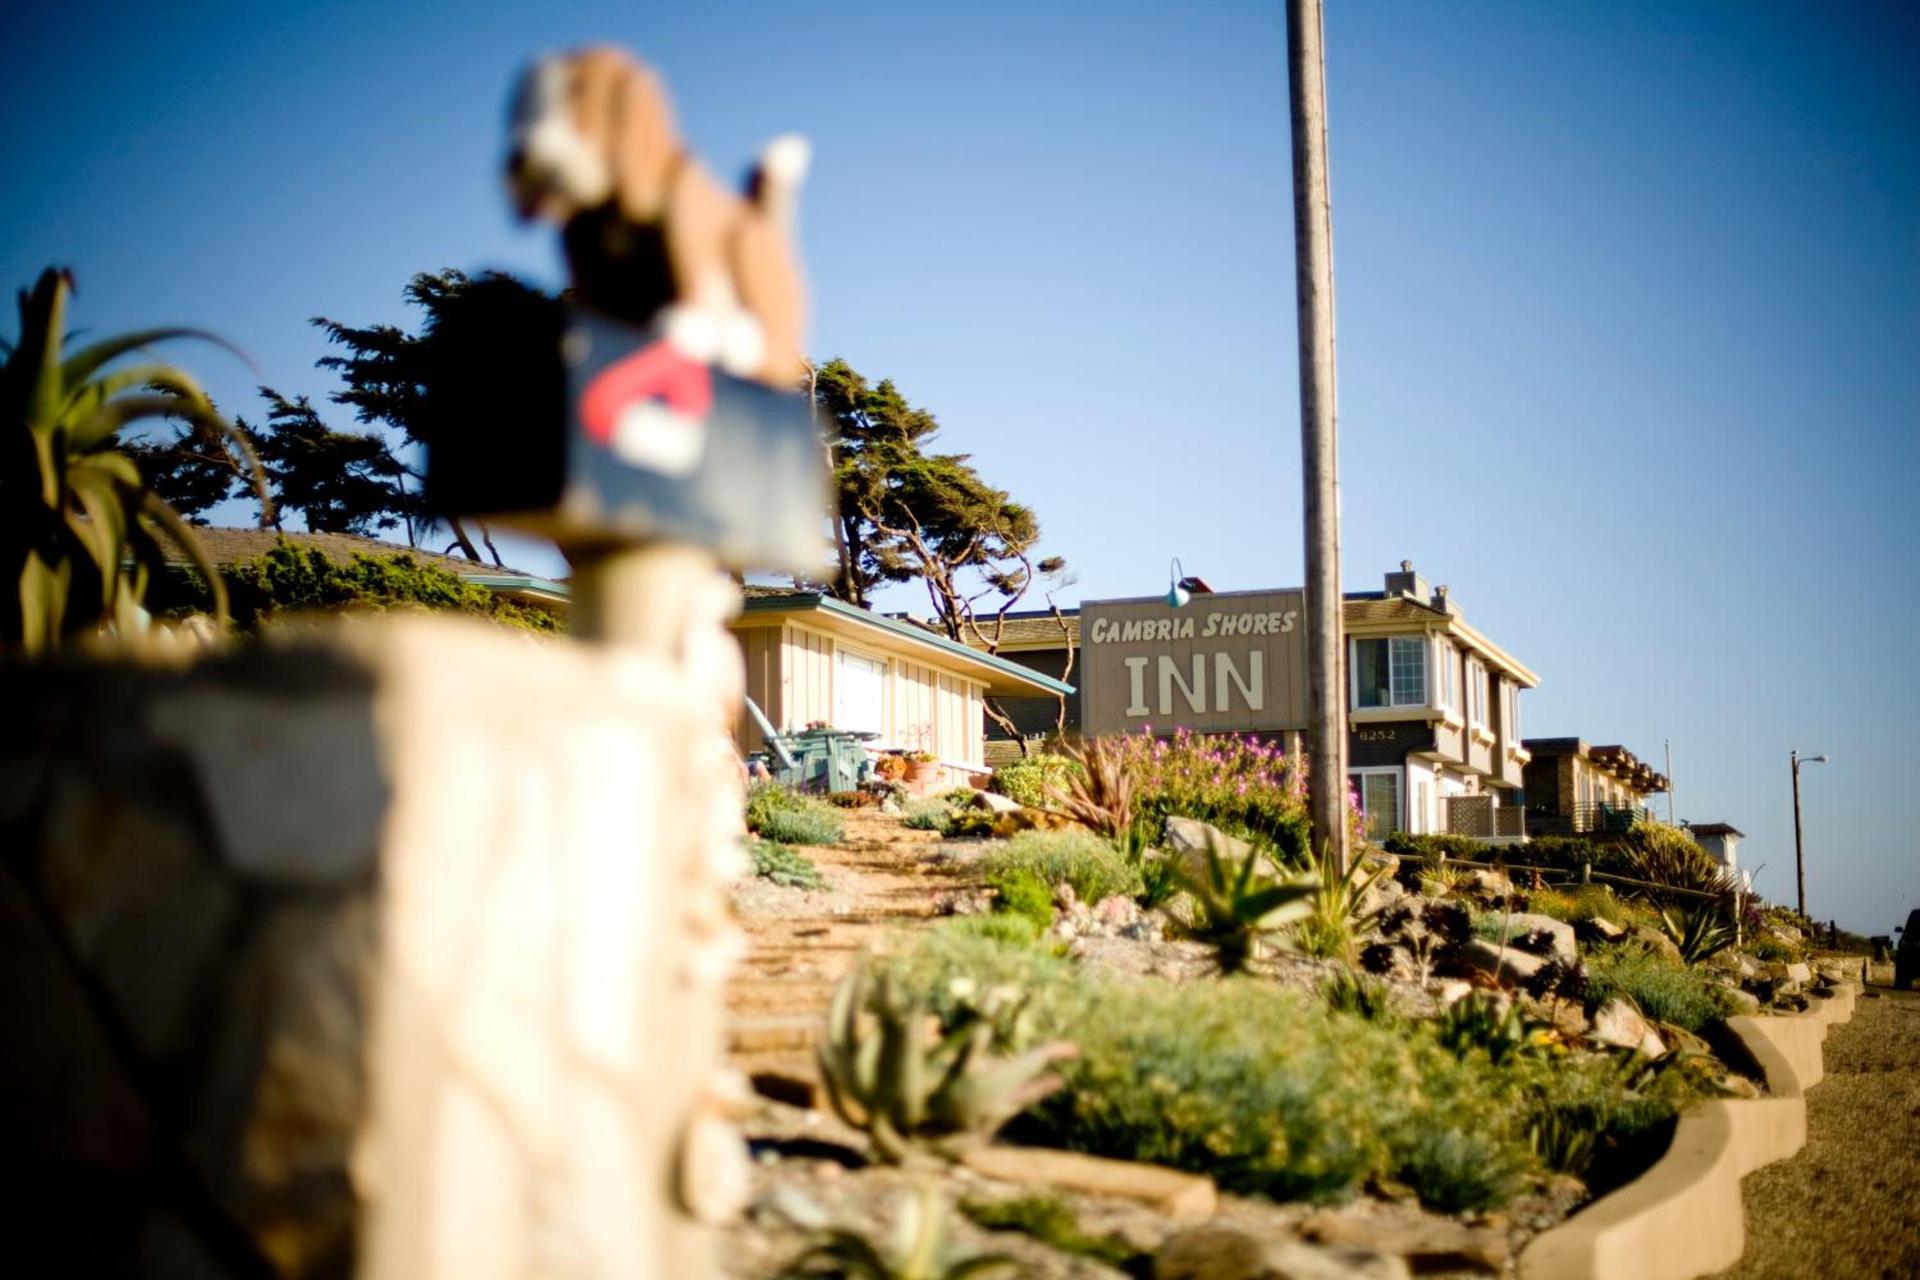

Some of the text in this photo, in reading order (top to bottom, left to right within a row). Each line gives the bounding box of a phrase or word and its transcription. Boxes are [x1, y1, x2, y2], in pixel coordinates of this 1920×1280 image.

[1091, 611, 1298, 644] CAMBRIA SHORES
[1124, 651, 1264, 717] INN
